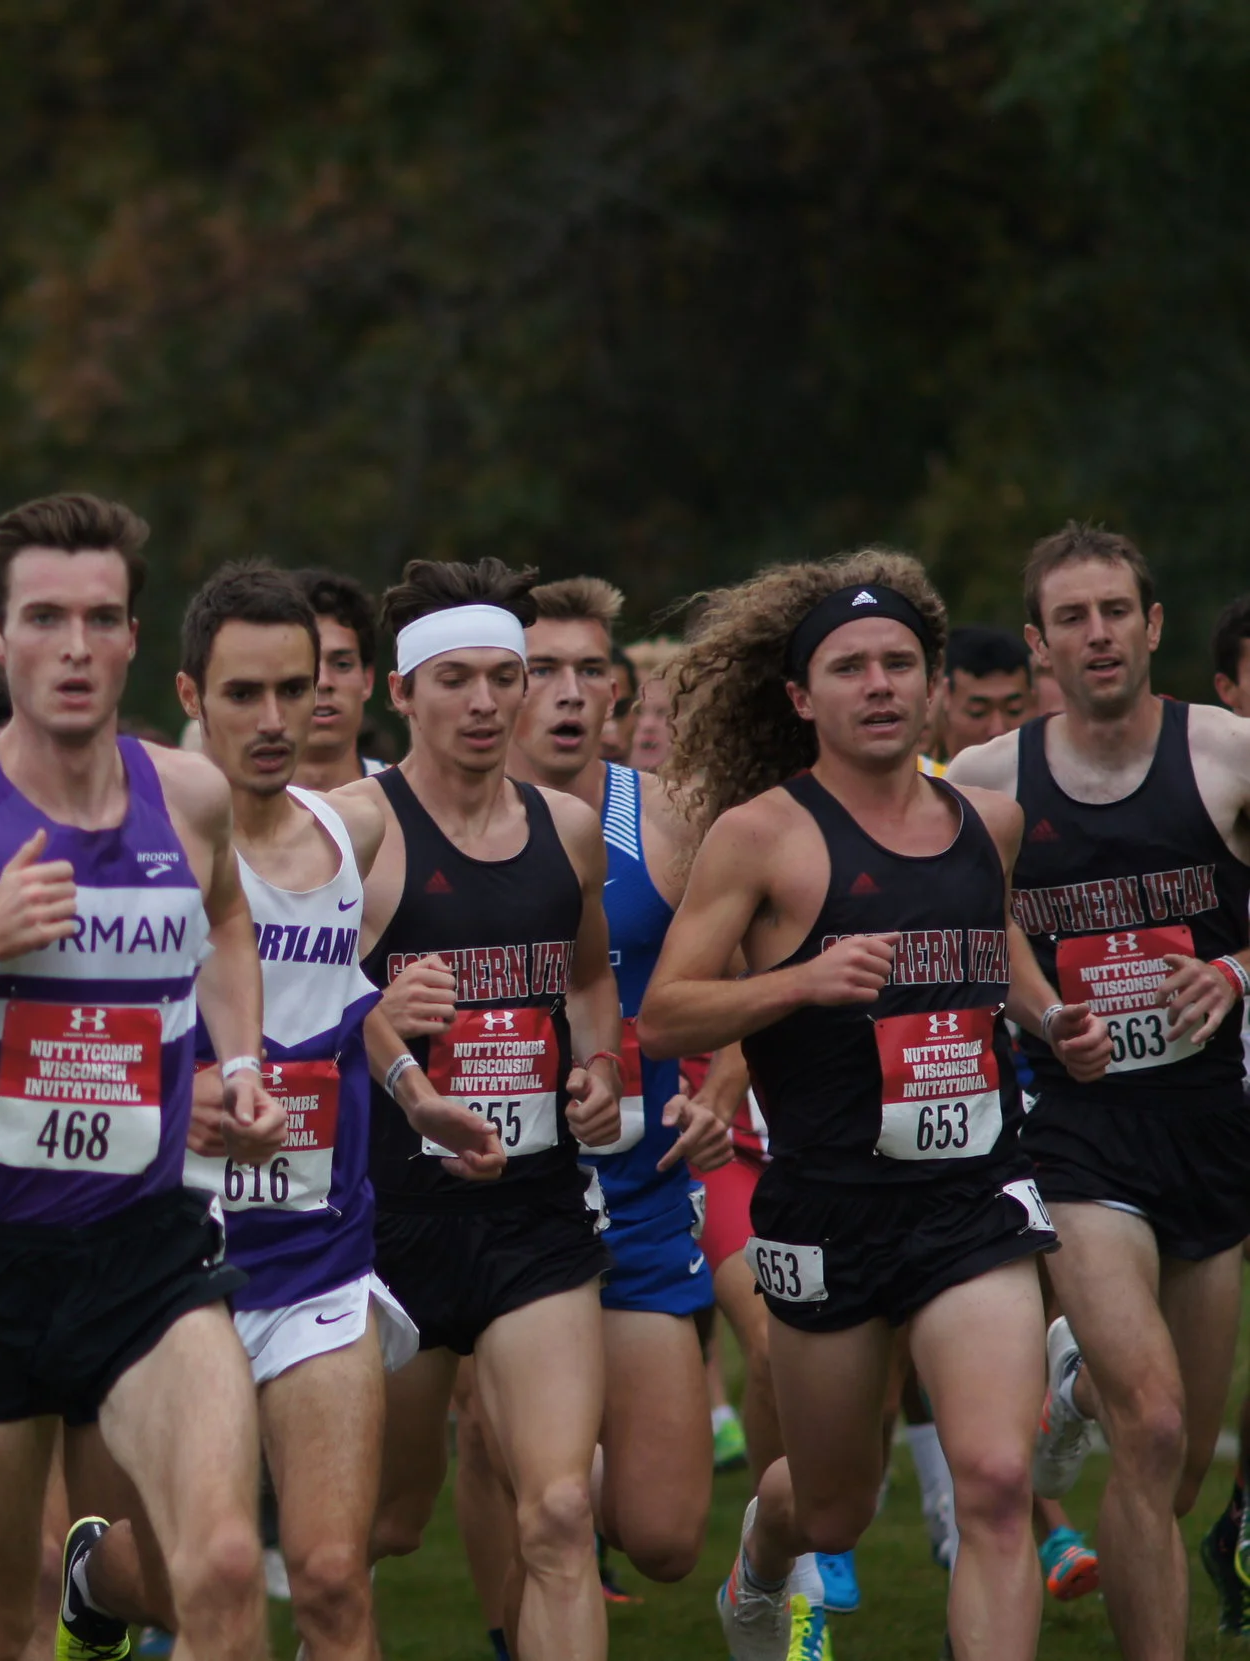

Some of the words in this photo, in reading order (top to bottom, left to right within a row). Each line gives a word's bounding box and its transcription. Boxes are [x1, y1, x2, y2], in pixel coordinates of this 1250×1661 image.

[136, 851, 180, 863] BROOKS
[1142, 863, 1219, 921] UTAH
[58, 913, 187, 953] RMAN
[1080, 957, 1173, 983] NUTTYCOMB
[30, 1038, 144, 1063] NUTTYCOMBE
[453, 1039, 546, 1059] NUTTYCOMBE
[1107, 1014, 1166, 1063] 663
[902, 1039, 984, 1065] NUTTYCOMBE
[38, 1059, 128, 1082] WISCONSIN
[461, 1057, 534, 1075] WISCONSIN
[912, 1058, 979, 1081] WISCONSIN
[24, 1077, 143, 1102] INVITATIONAL
[449, 1074, 543, 1092] INVITATIONAL
[902, 1073, 988, 1099] INVITATIONAL
[36, 1109, 112, 1161] 468
[916, 1101, 969, 1152] 653
[223, 1157, 290, 1204] 616
[756, 1246, 802, 1298] 653
